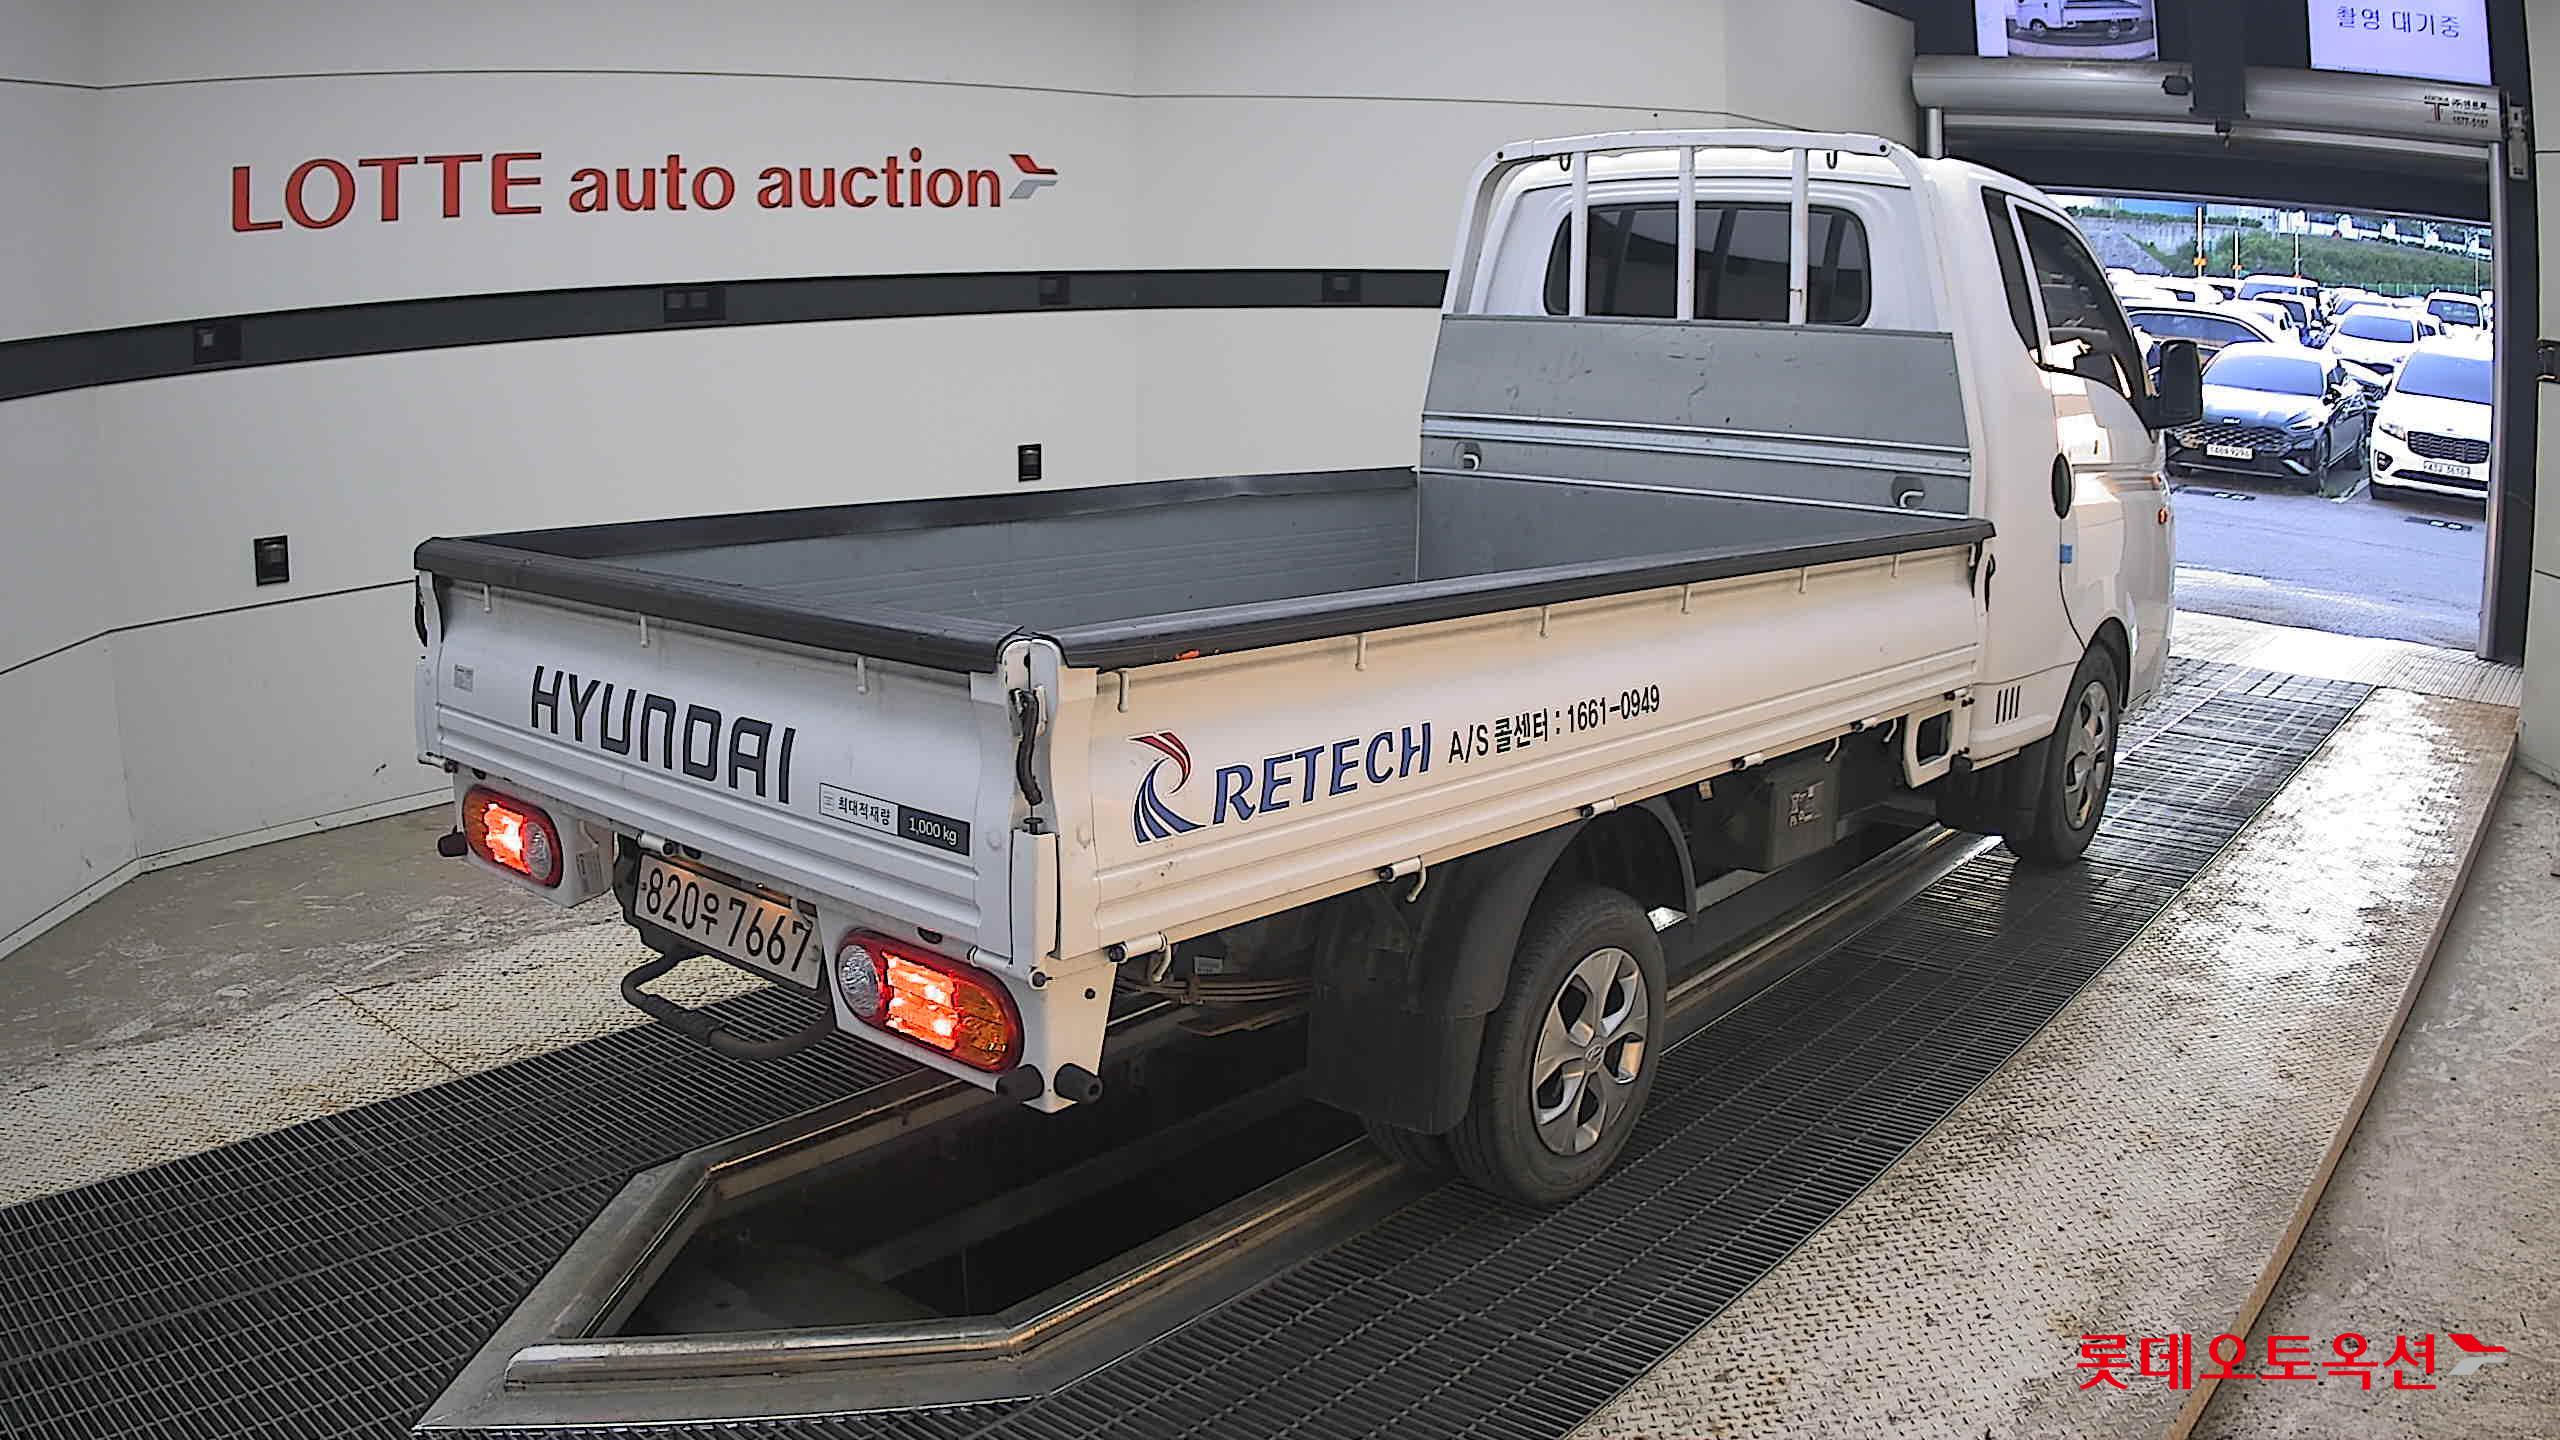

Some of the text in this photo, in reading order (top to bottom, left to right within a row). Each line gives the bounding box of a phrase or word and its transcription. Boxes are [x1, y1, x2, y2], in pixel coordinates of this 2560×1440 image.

[2337, 6, 2460, 39] 촬영 대기중
[232, 146, 1002, 233] LOTTE auto auction
[531, 664, 797, 804] HYUNDAI
[1448, 723, 1490, 763] A/S
[1494, 707, 1549, 754] 콜센터
[1567, 684, 1660, 733] 1661-0949
[1212, 722, 1433, 826] RETECH
[837, 795, 958, 846] 최대적재량 1,000 kg
[646, 867, 720, 936] 820우
[728, 897, 814, 973] 7667
